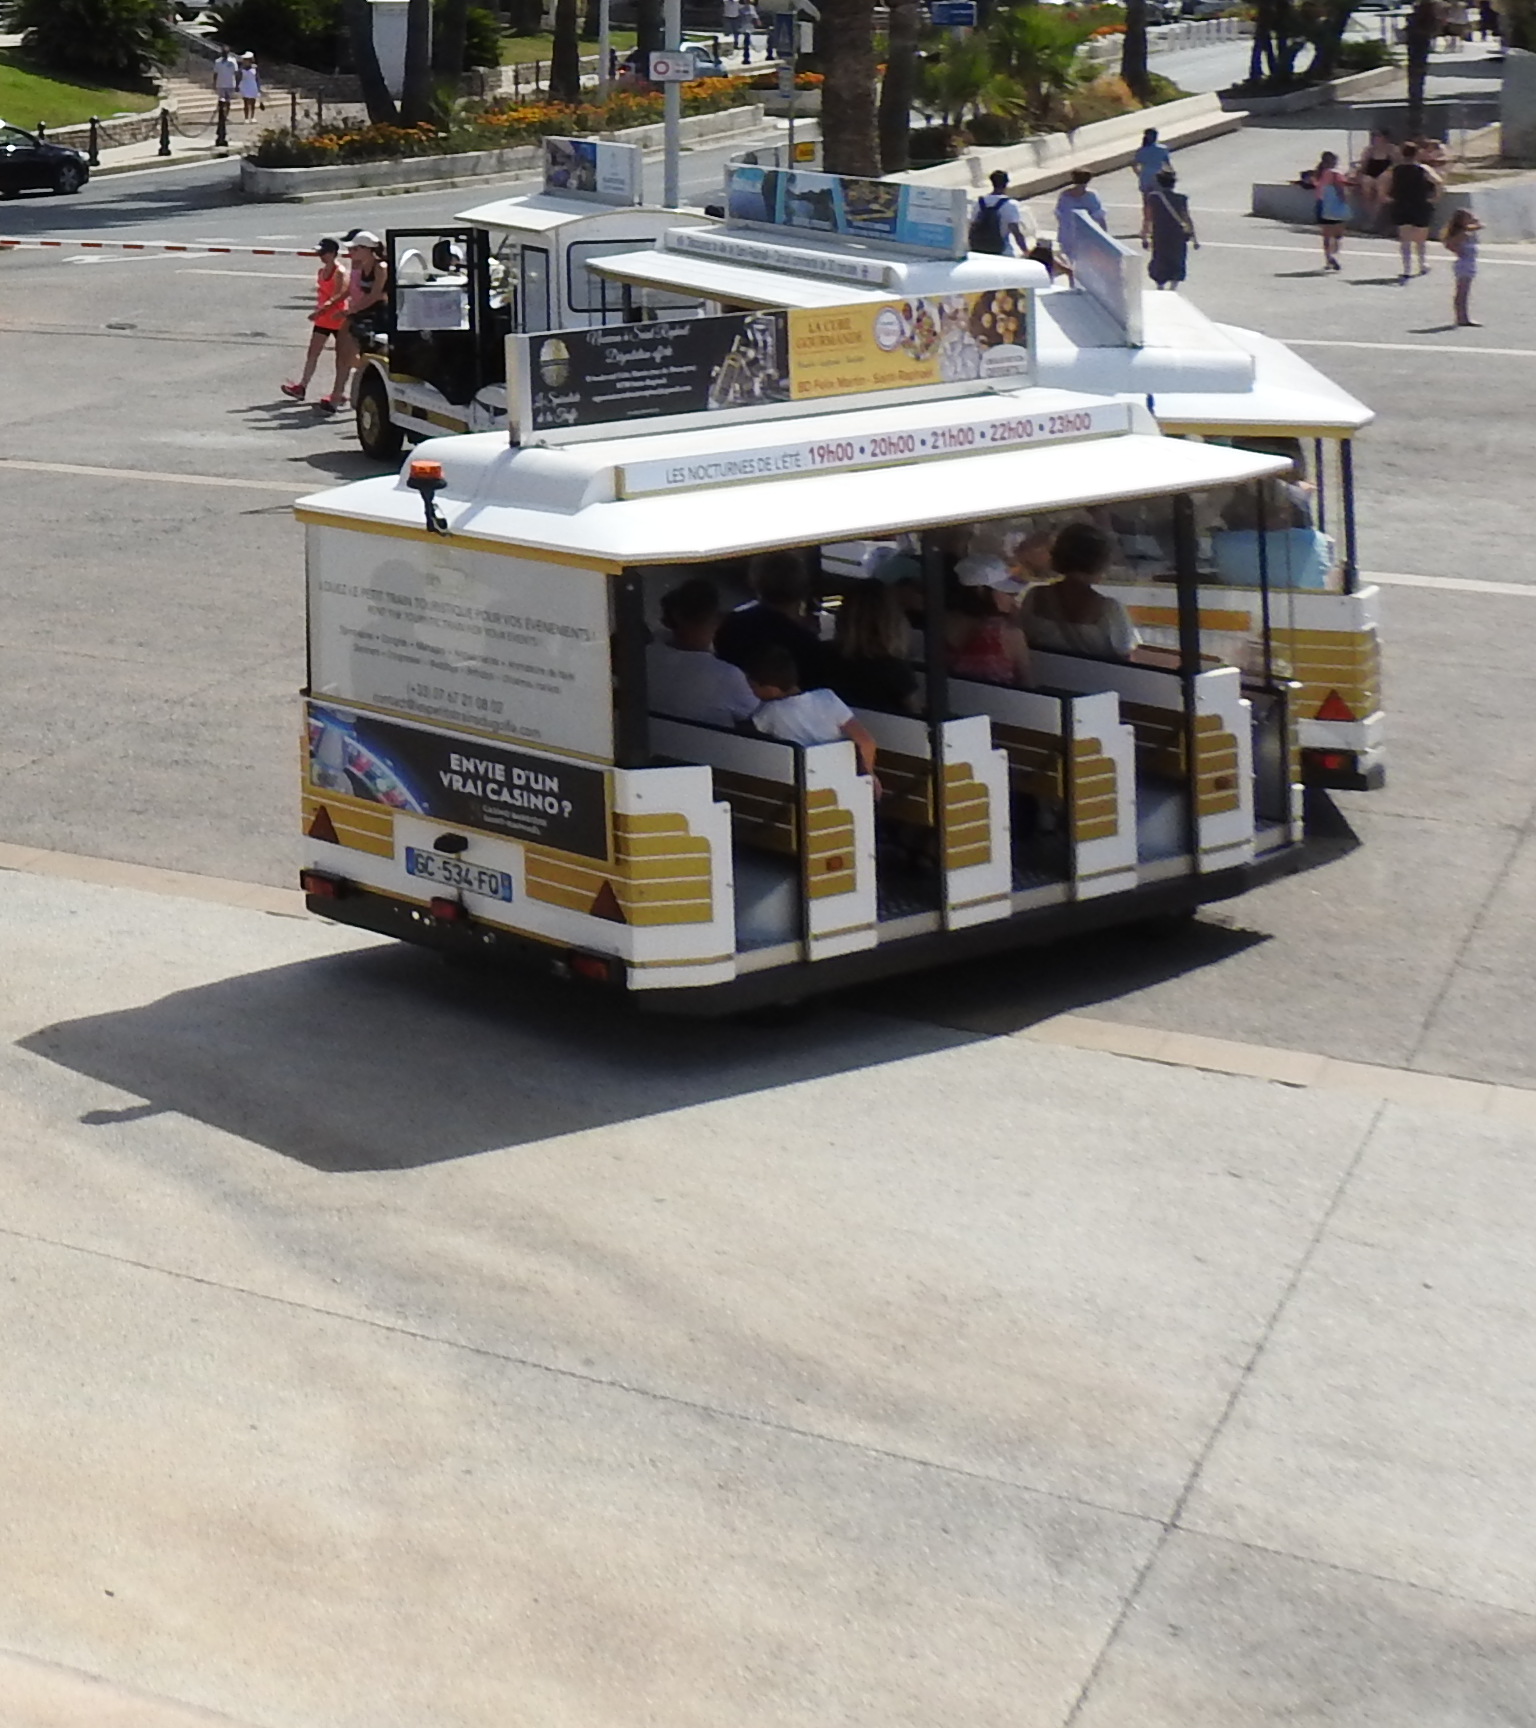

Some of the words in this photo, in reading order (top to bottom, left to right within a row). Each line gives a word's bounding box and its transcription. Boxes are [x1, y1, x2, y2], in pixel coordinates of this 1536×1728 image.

[665, 466, 686, 485] LES
[687, 458, 755, 482] NOCTURNES
[757, 455, 773, 473] DE
[808, 441, 855, 467] 19h00
[870, 435, 916, 459] 20h00
[930, 425, 975, 451] 21h00
[990, 419, 1034, 443] 22h00
[1048, 411, 1093, 435] 23h00
[439, 770, 482, 798] VRAI
[450, 752, 506, 783] ENVIE
[512, 767, 560, 794] D'UN
